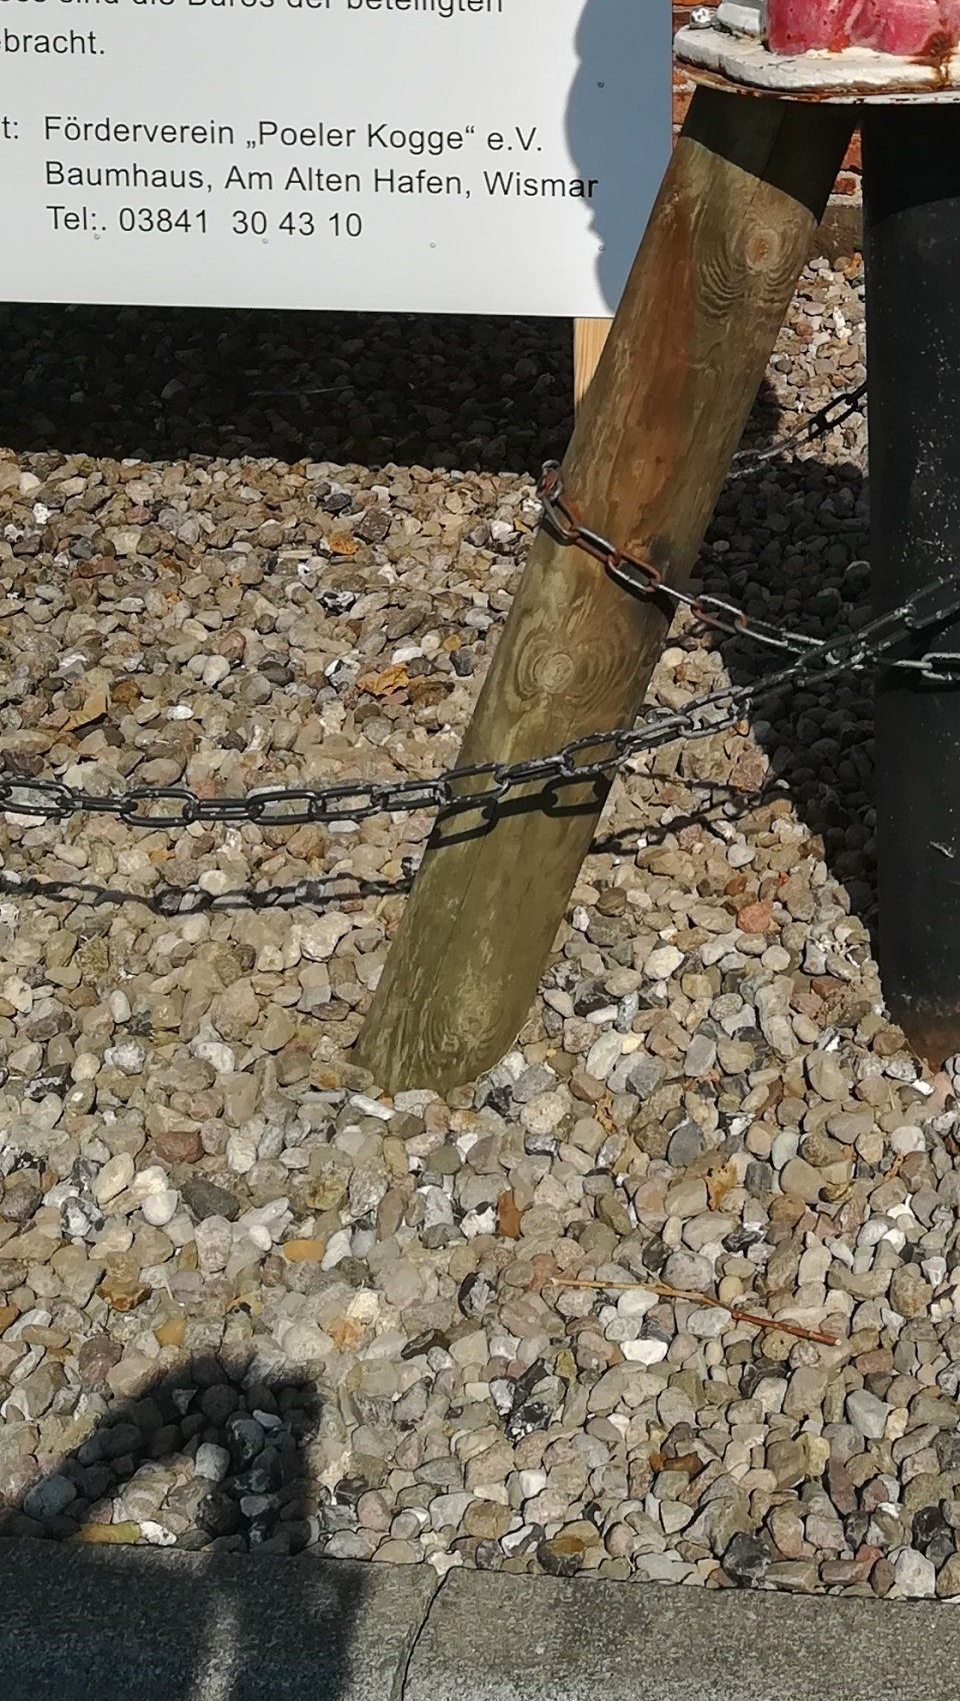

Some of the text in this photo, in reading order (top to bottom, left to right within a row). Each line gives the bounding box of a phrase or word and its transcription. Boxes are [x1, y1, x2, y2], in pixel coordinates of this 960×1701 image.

[0, 27, 105, 55] bracht.
[44, 115, 234, 145] Förderverein
[487, 126, 542, 152] e.V.
[45, 160, 600, 199] Baumhaus, Am Alten Hafen, Wismar
[119, 207, 206, 234] 03841
[232, 210, 268, 235] 30
[278, 211, 315, 236] 43
[328, 212, 362, 237] 10
